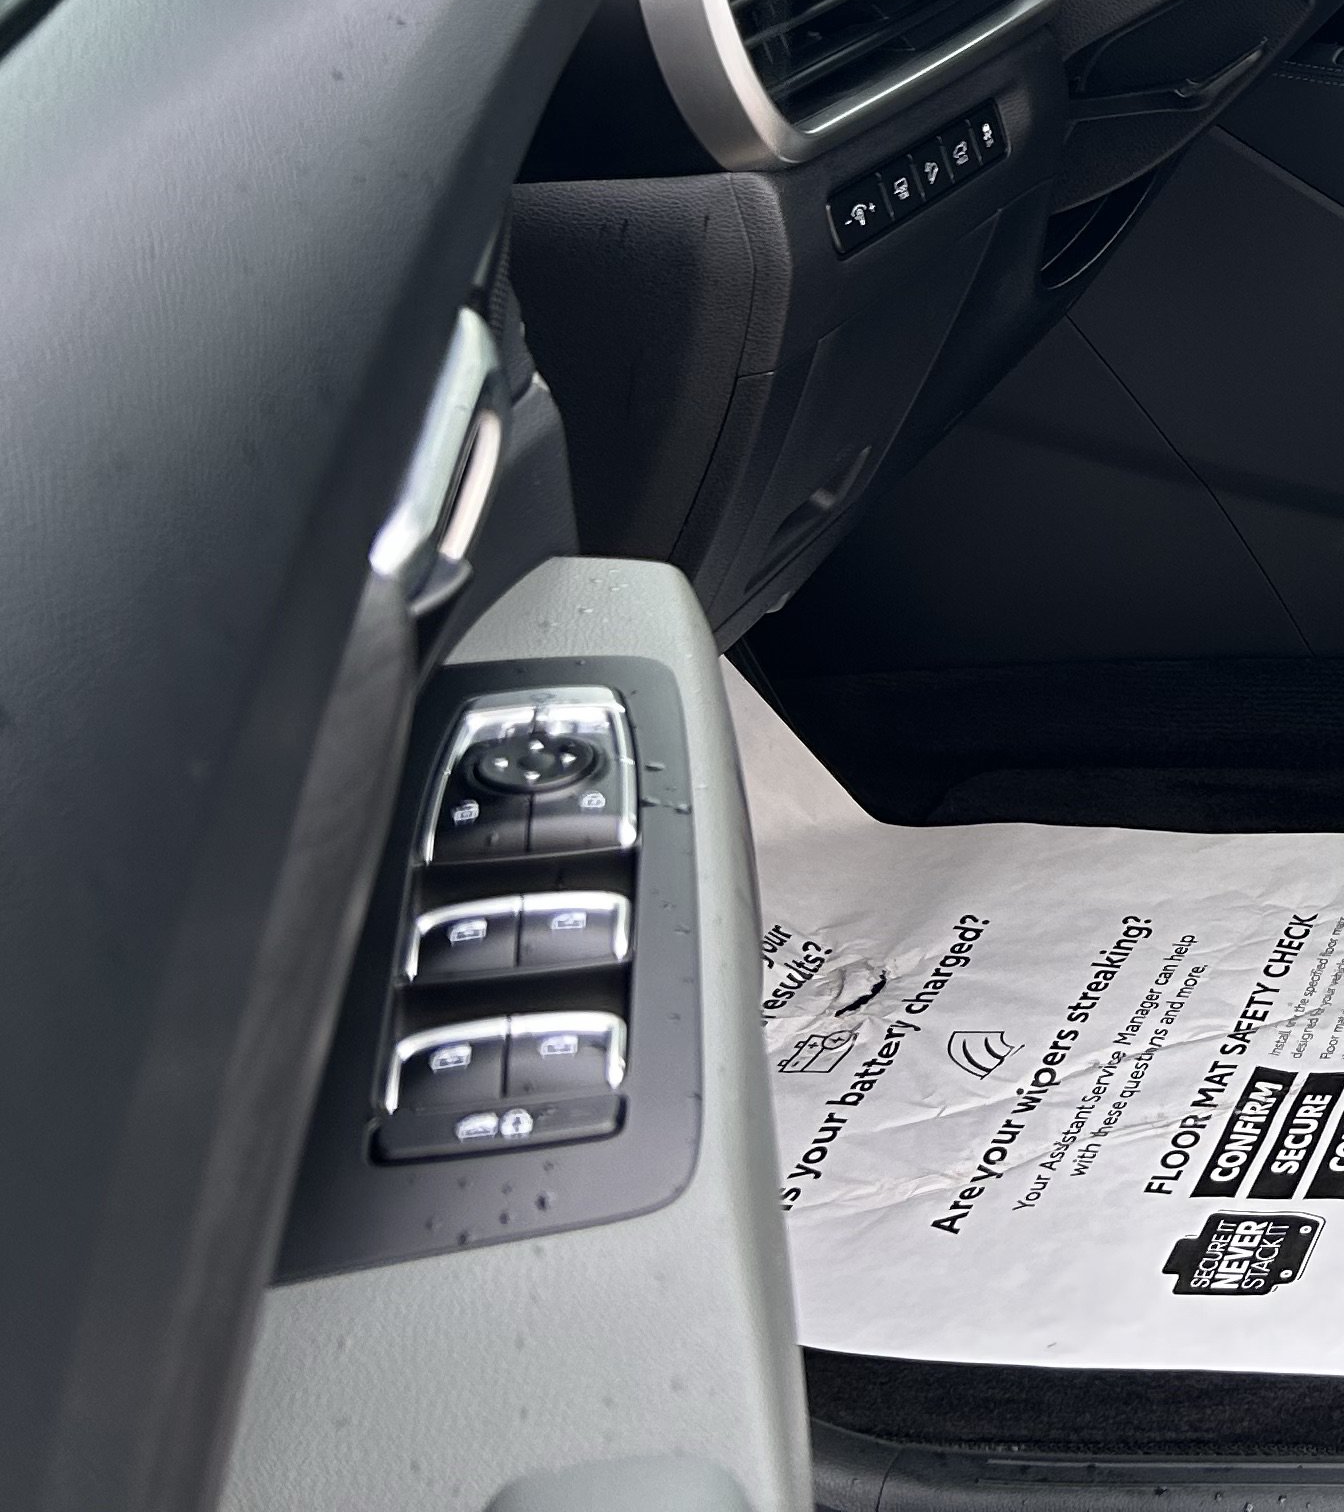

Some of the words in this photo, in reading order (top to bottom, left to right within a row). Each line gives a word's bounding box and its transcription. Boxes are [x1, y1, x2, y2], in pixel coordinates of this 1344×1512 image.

[787, 1112, 848, 1179] your
[826, 1020, 921, 1106] battery
[902, 914, 990, 1014] charged?
[930, 1186, 986, 1234] Are
[972, 1119, 1025, 1182] your
[1011, 1029, 1080, 1114] wipers
[1067, 915, 1153, 1023] streaking?
[1012, 1174, 1051, 1211] Your
[1090, 1050, 1128, 1102] Service
[1113, 988, 1162, 1045] Manager
[1154, 964, 1177, 987] can
[1170, 934, 1199, 965] help
[1070, 1142, 1101, 1177] with
[1160, 1000, 1184, 1025] and
[1176, 964, 1208, 999] more.
[1144, 1113, 1212, 1194] FLOOR
[1190, 1060, 1238, 1108] MAT
[1220, 982, 1280, 1055] SAFETY
[1263, 913, 1318, 978] CHECK
[1268, 1029, 1291, 1056] Install
[1294, 998, 1309, 1013] the
[1210, 1081, 1283, 1182] CONFIRM
[1270, 1094, 1332, 1175] SECURE
[1190, 1234, 1233, 1288] SECURE
[1216, 1219, 1238, 1233] IT
[1209, 1220, 1268, 1290] NEVER
[1241, 1237, 1283, 1290] STACK
[1267, 1222, 1290, 1236] IT
